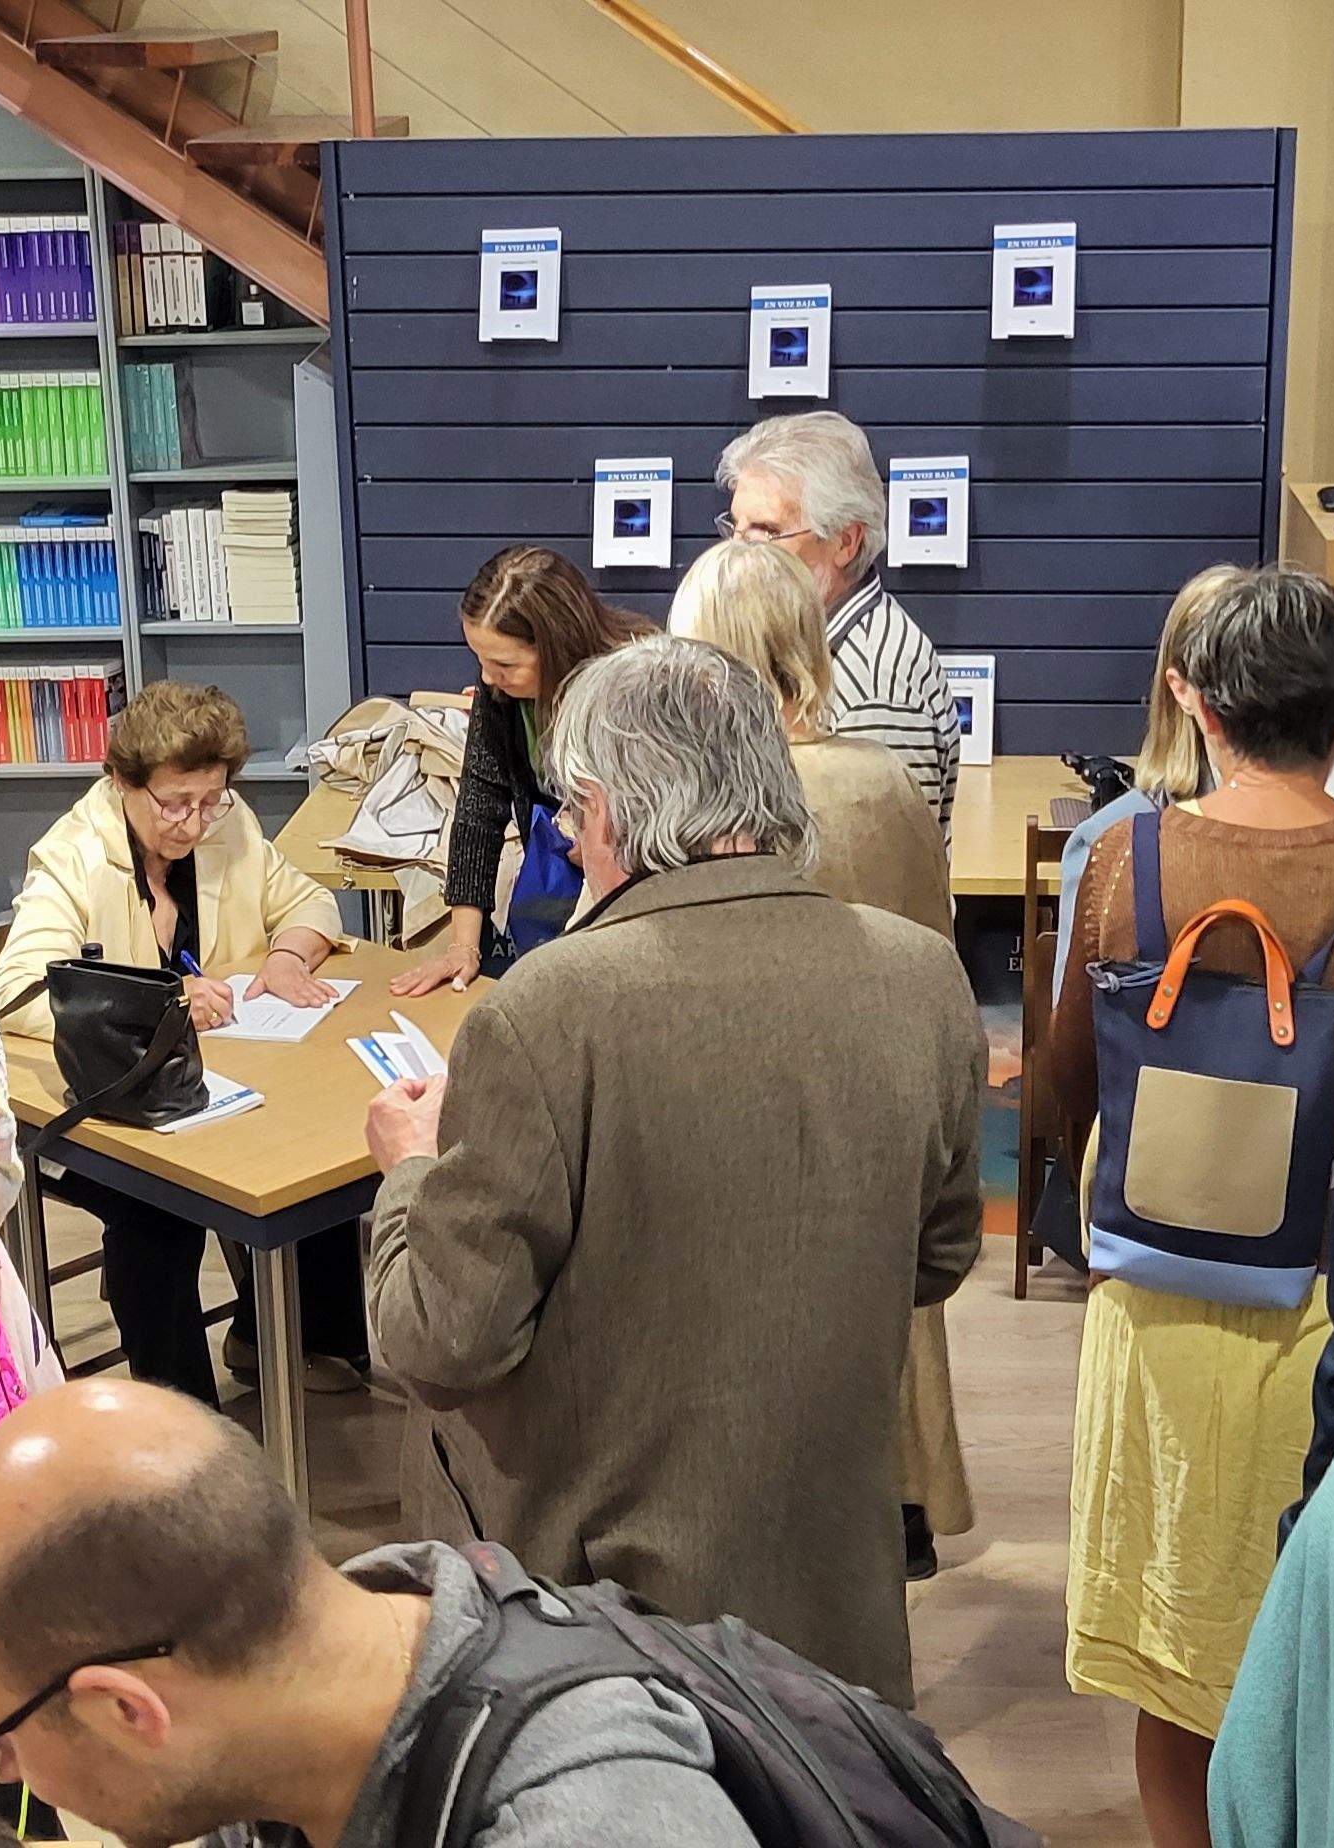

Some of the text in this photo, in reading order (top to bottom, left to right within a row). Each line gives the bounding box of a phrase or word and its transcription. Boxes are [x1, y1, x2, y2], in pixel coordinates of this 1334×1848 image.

[507, 244, 524, 252] VOZ
[526, 243, 546, 251] BAJA
[1021, 240, 1039, 248] VOZ
[1041, 239, 1063, 247] BAJA
[620, 473, 637, 481] VOZ
[638, 472, 659, 480] BAJA
[916, 472, 933, 480] VOZ
[935, 471, 955, 479] BAJA
[948, 670, 981, 678] OZ BAJA
